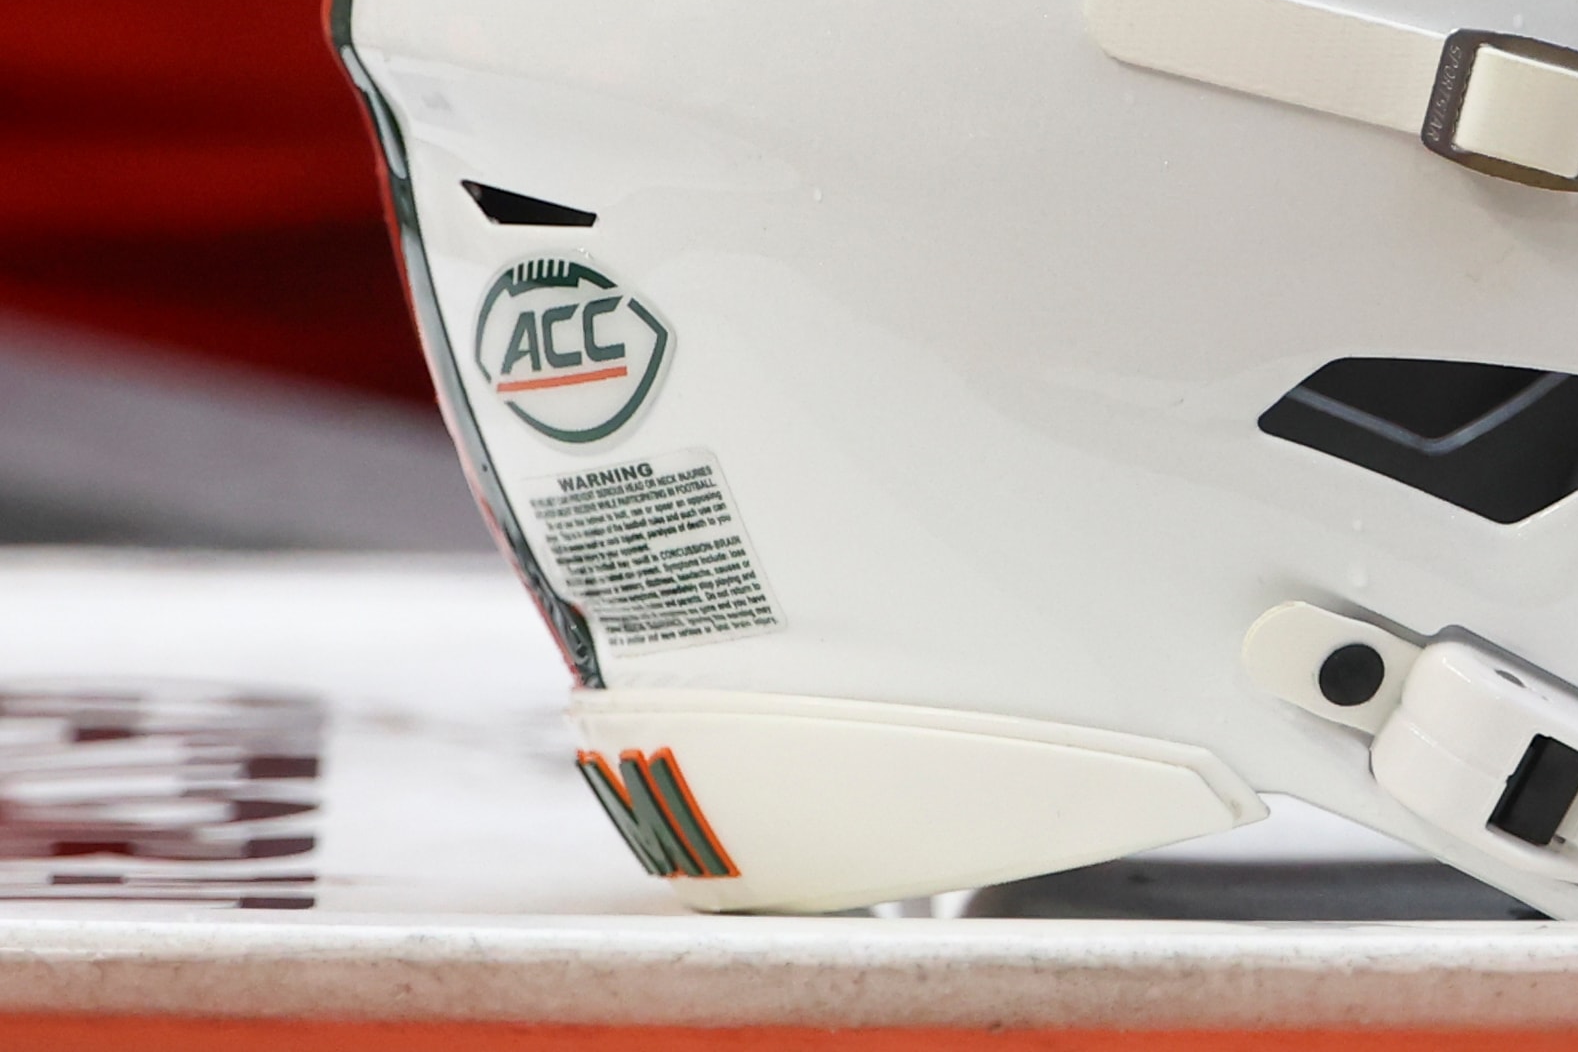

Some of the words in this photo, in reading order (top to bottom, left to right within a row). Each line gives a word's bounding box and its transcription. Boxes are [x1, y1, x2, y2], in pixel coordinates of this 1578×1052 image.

[501, 295, 627, 375] ACC
[558, 463, 653, 492] WARNING
[625, 481, 644, 491] HEAD
[657, 474, 677, 484] NECK
[677, 466, 712, 480] INJURIES
[675, 478, 717, 493] FOOTBALL.
